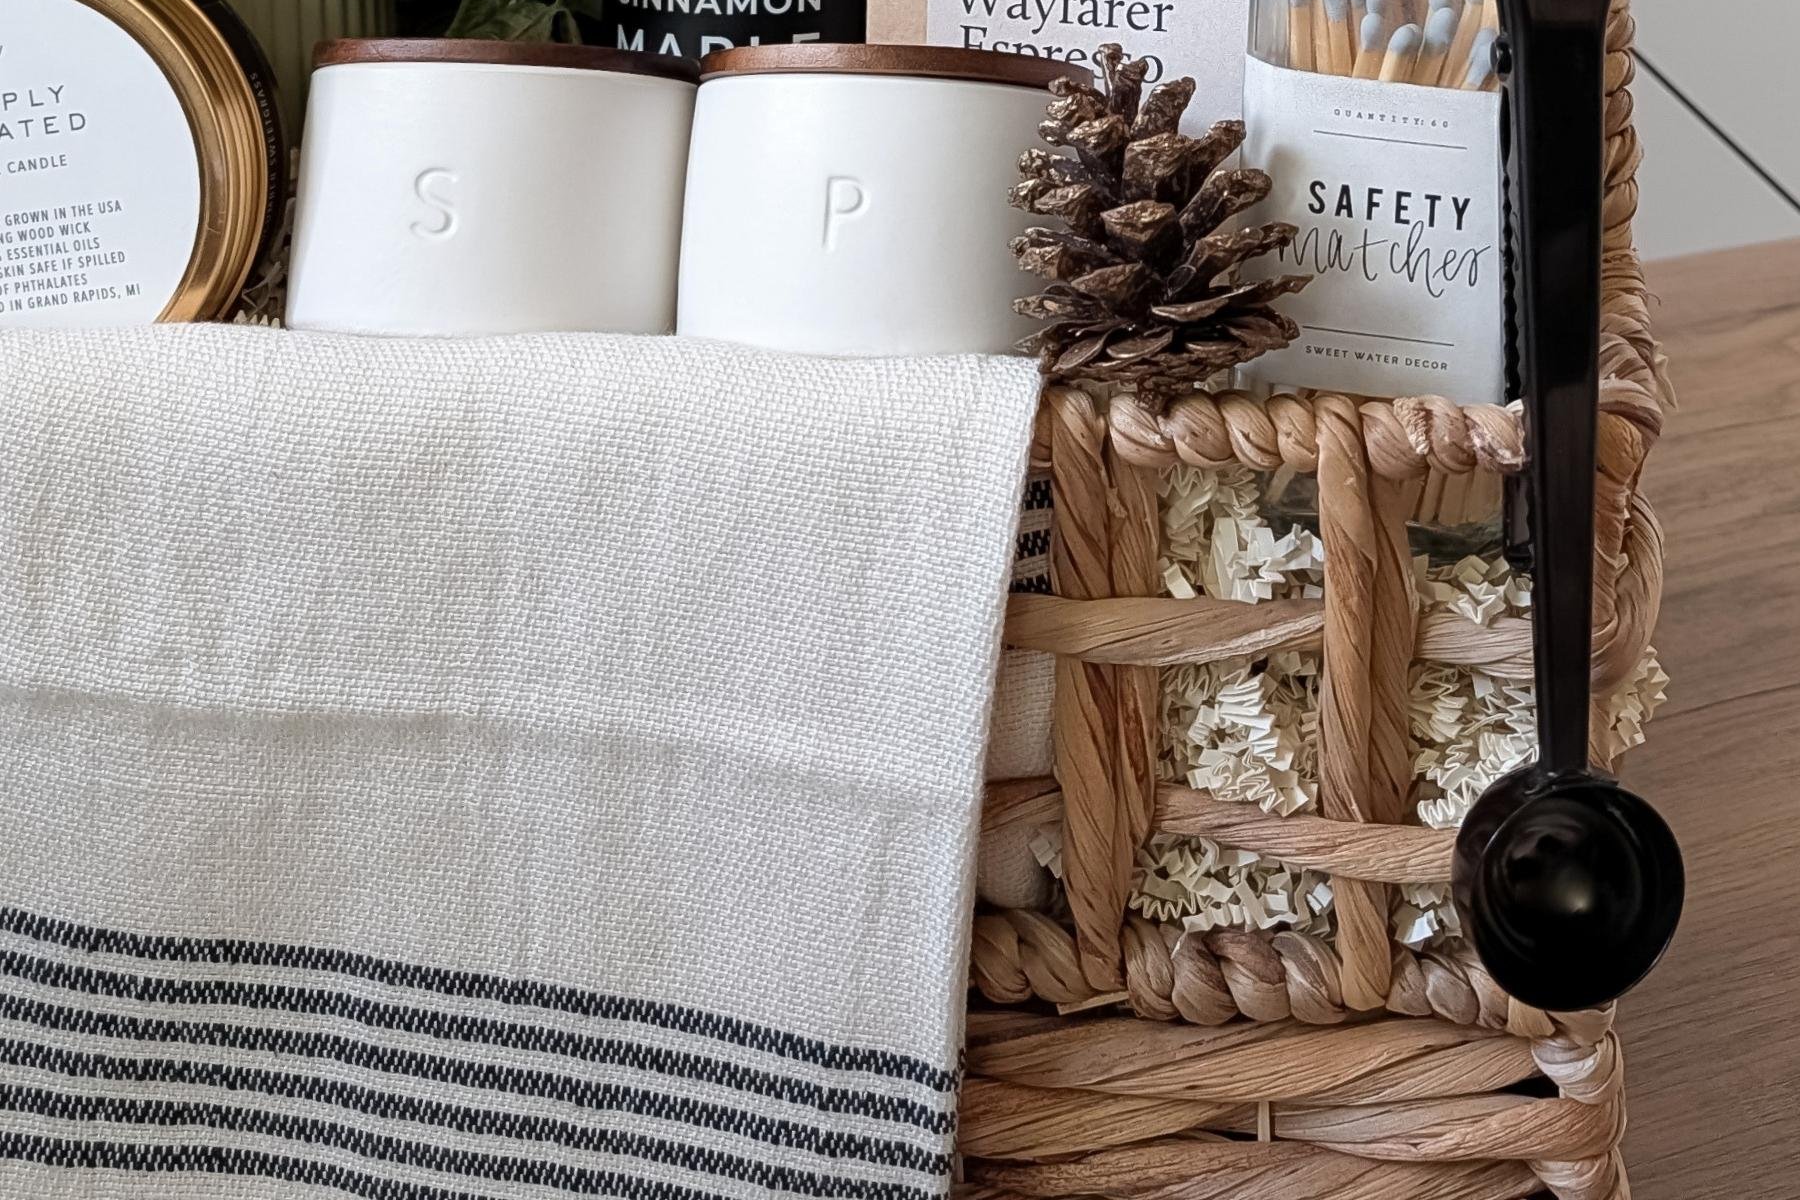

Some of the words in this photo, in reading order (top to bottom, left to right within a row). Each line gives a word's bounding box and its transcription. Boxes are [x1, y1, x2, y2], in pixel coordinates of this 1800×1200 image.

[616, 23, 821, 58] MAP
[1334, 108, 1425, 126] QUANTITY:
[7, 154, 68, 174] CANDLE
[4, 209, 49, 227] GROWN
[54, 207, 67, 220] IN
[71, 203, 94, 218] THE
[98, 200, 122, 214] USA
[410, 166, 460, 242] S
[822, 174, 871, 254] P
[1307, 180, 1472, 231] SAFETY
[17, 226, 55, 242] WOOD
[59, 221, 91, 237] WICK
[7, 242, 70, 261] ESSENTIAL
[73, 237, 100, 253] OILS
[29, 259, 58, 275] SAFE
[62, 257, 73, 270] IF
[78, 251, 126, 269] SPILLED
[14, 273, 88, 294] PHTHALATES
[10, 298, 23, 312] IN
[27, 293, 69, 310] GRAND
[73, 286, 121, 303] RAPIDS,
[125, 283, 141, 297] MI
[1305, 345, 1349, 358] SWEET
[1354, 351, 1399, 364] WATER
[1405, 357, 1449, 371] DECOR
